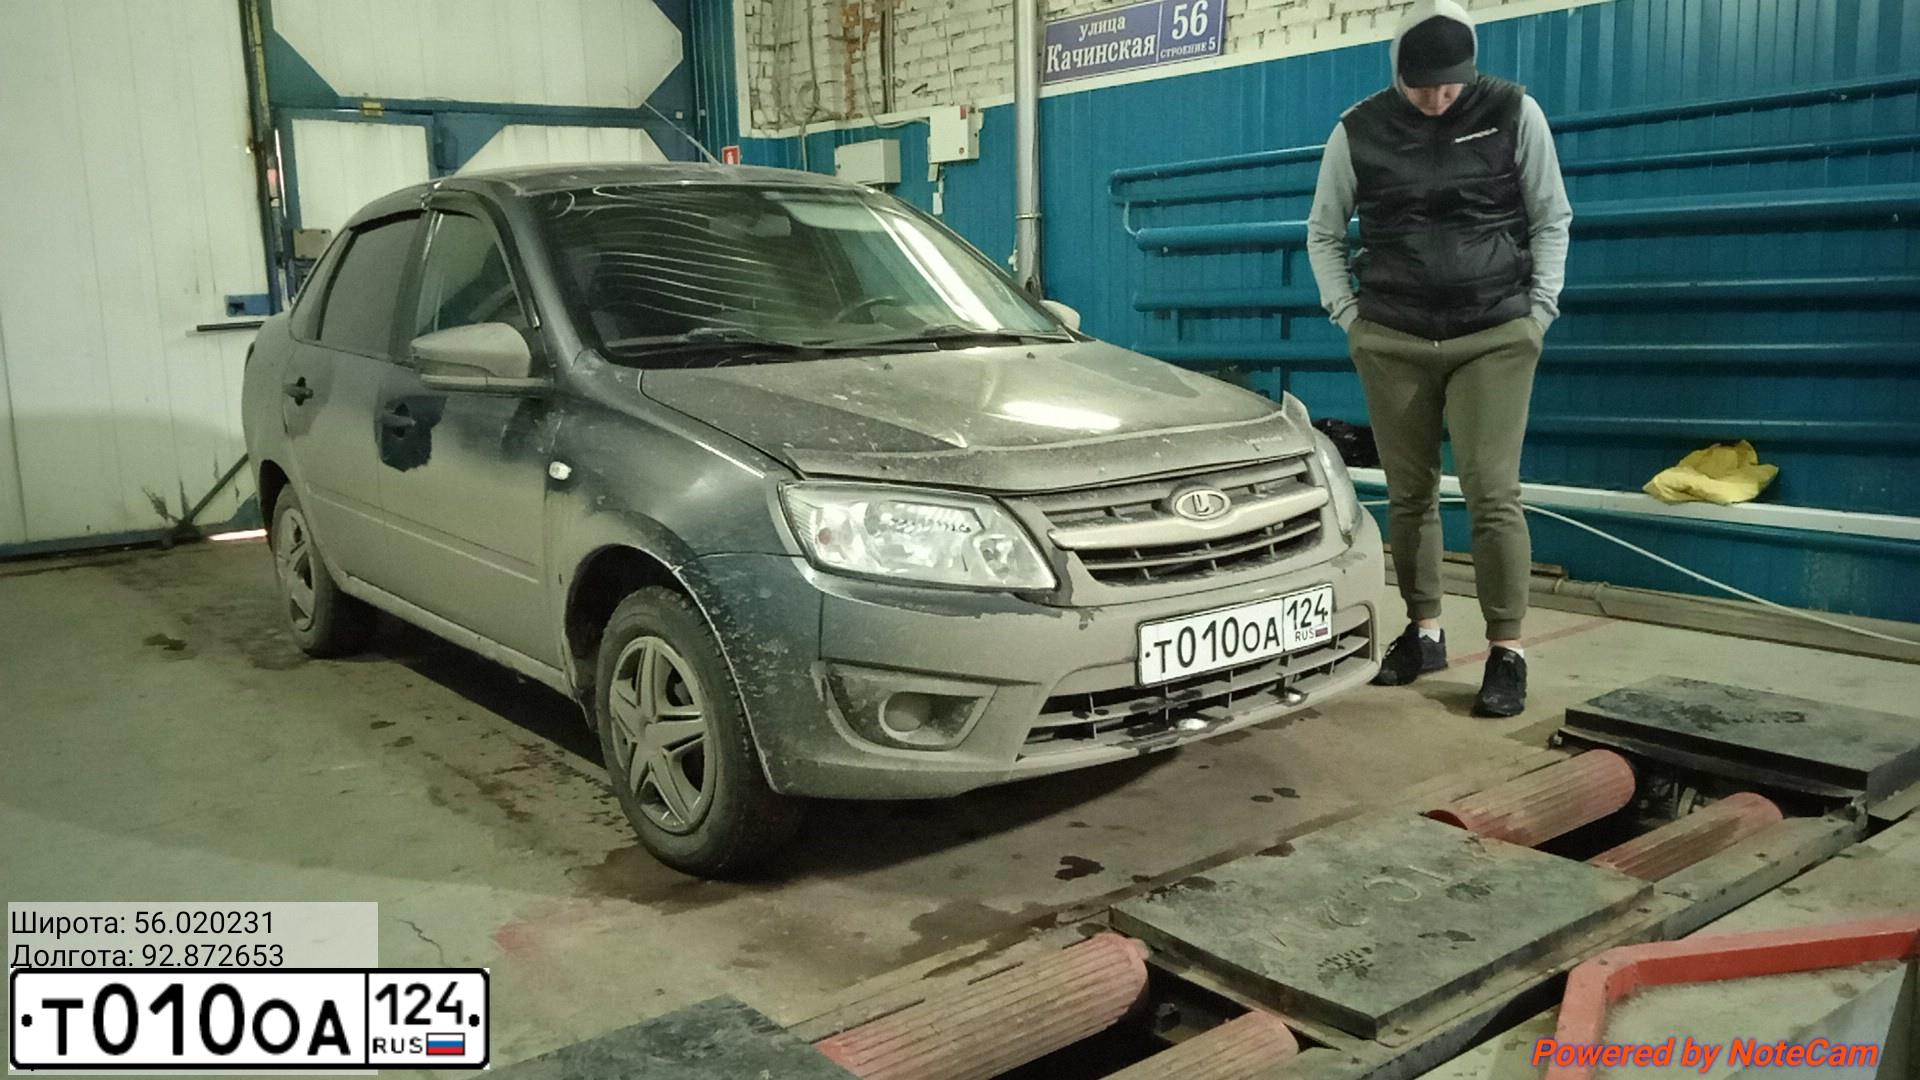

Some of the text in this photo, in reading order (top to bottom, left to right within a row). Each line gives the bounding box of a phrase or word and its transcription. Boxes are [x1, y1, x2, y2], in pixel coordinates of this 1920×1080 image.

[1078, 15, 1126, 42] улица
[1172, 0, 1208, 40] 56
[1046, 33, 1156, 74] Качинская
[1208, 36, 1216, 51] 5
[1287, 593, 1326, 631] 124
[1295, 626, 1314, 642] RUS
